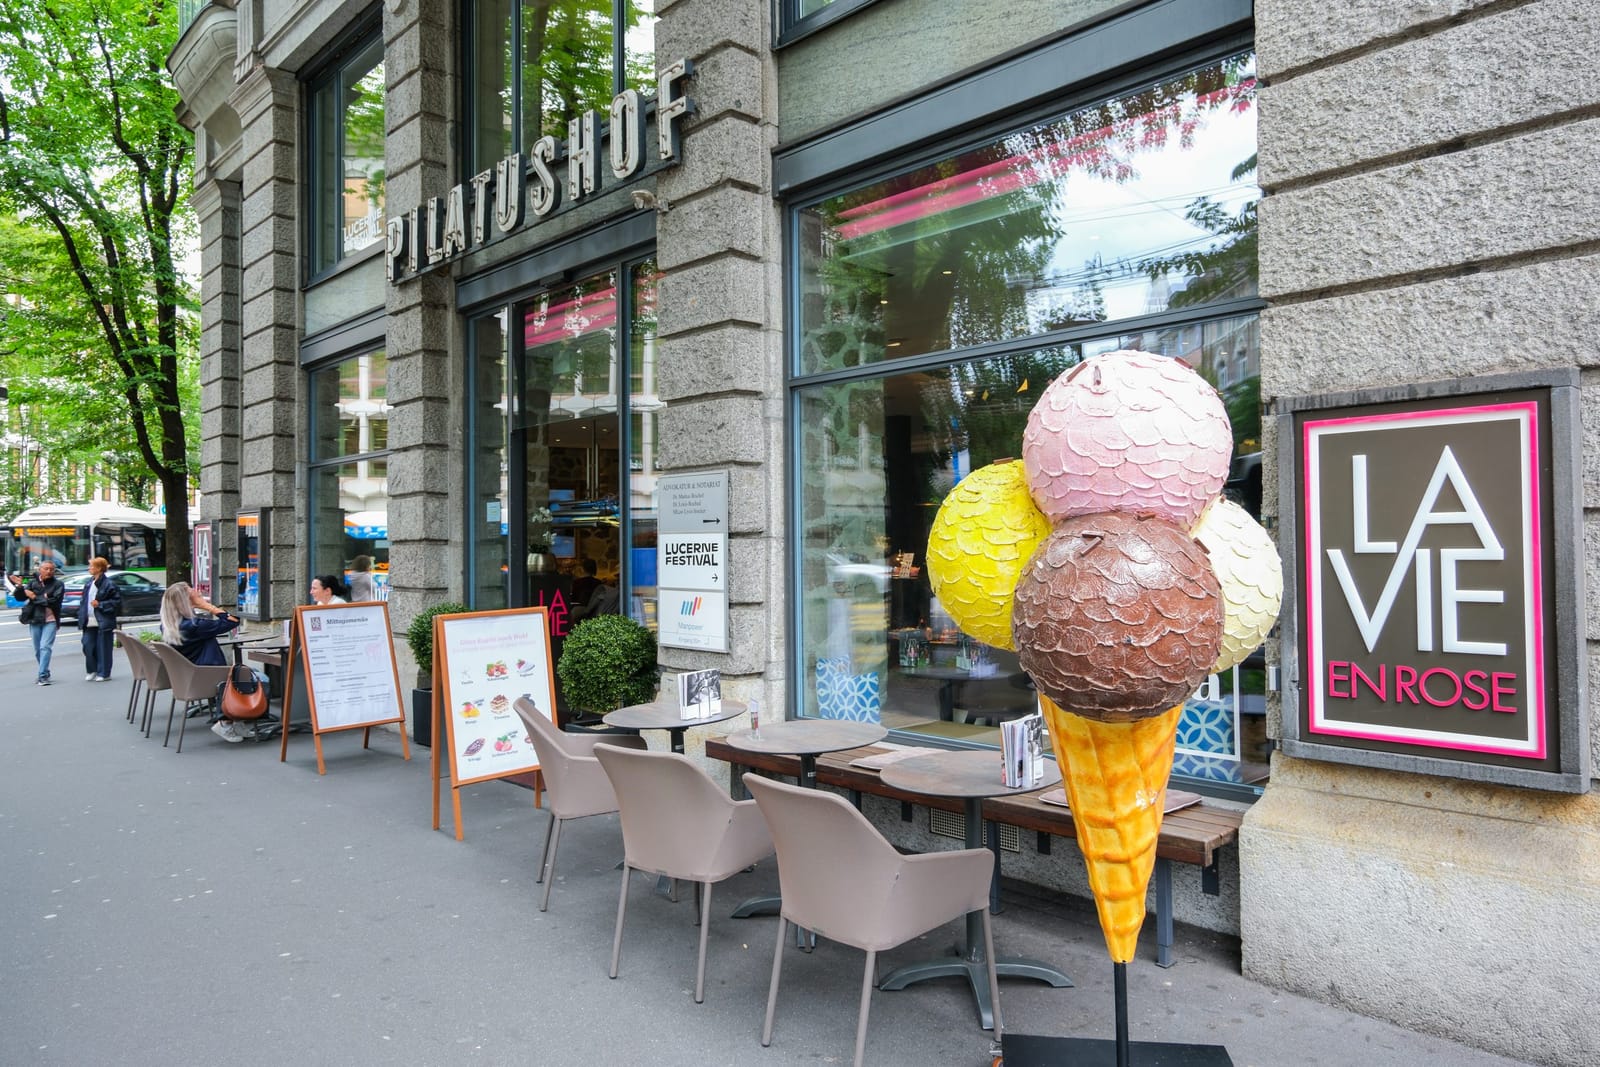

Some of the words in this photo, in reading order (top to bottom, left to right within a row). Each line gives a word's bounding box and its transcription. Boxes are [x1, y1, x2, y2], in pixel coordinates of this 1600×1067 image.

[385, 57, 694, 282] PILATUSHOF
[1352, 444, 1504, 555] LA
[665, 542, 719, 555] LUCERNE
[665, 553, 719, 566] FESTIVAL
[1326, 547, 1507, 656] VIE
[1328, 660, 1388, 702] EN
[1395, 665, 1518, 713] ROSE
